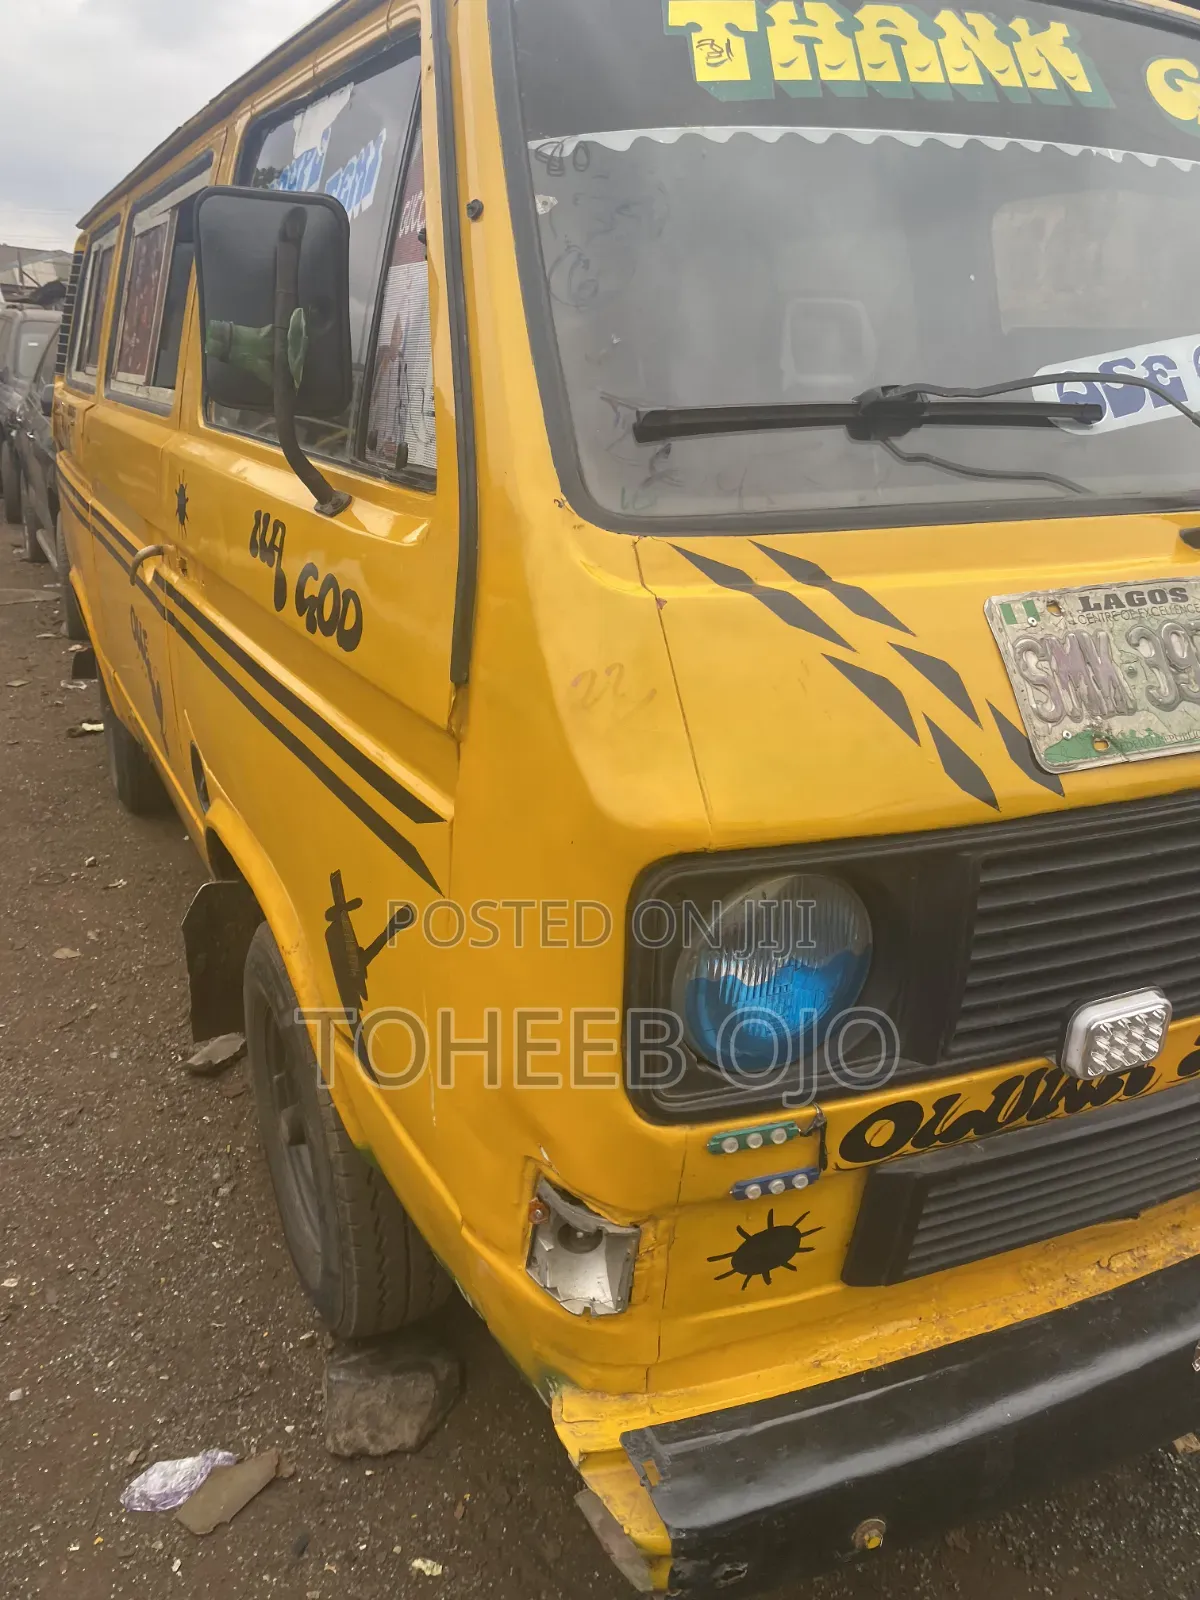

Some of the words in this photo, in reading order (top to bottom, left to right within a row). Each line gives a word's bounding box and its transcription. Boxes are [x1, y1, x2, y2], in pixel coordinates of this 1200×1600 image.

[667, 0, 1094, 94] THANK
[1146, 57, 1200, 124] G
[295, 562, 363, 652] GOD
[1077, 610, 1120, 625] CENTRE
[1078, 587, 1189, 612] LAGOS
[1012, 628, 1137, 726] SMK
[1125, 619, 1200, 712] 39
